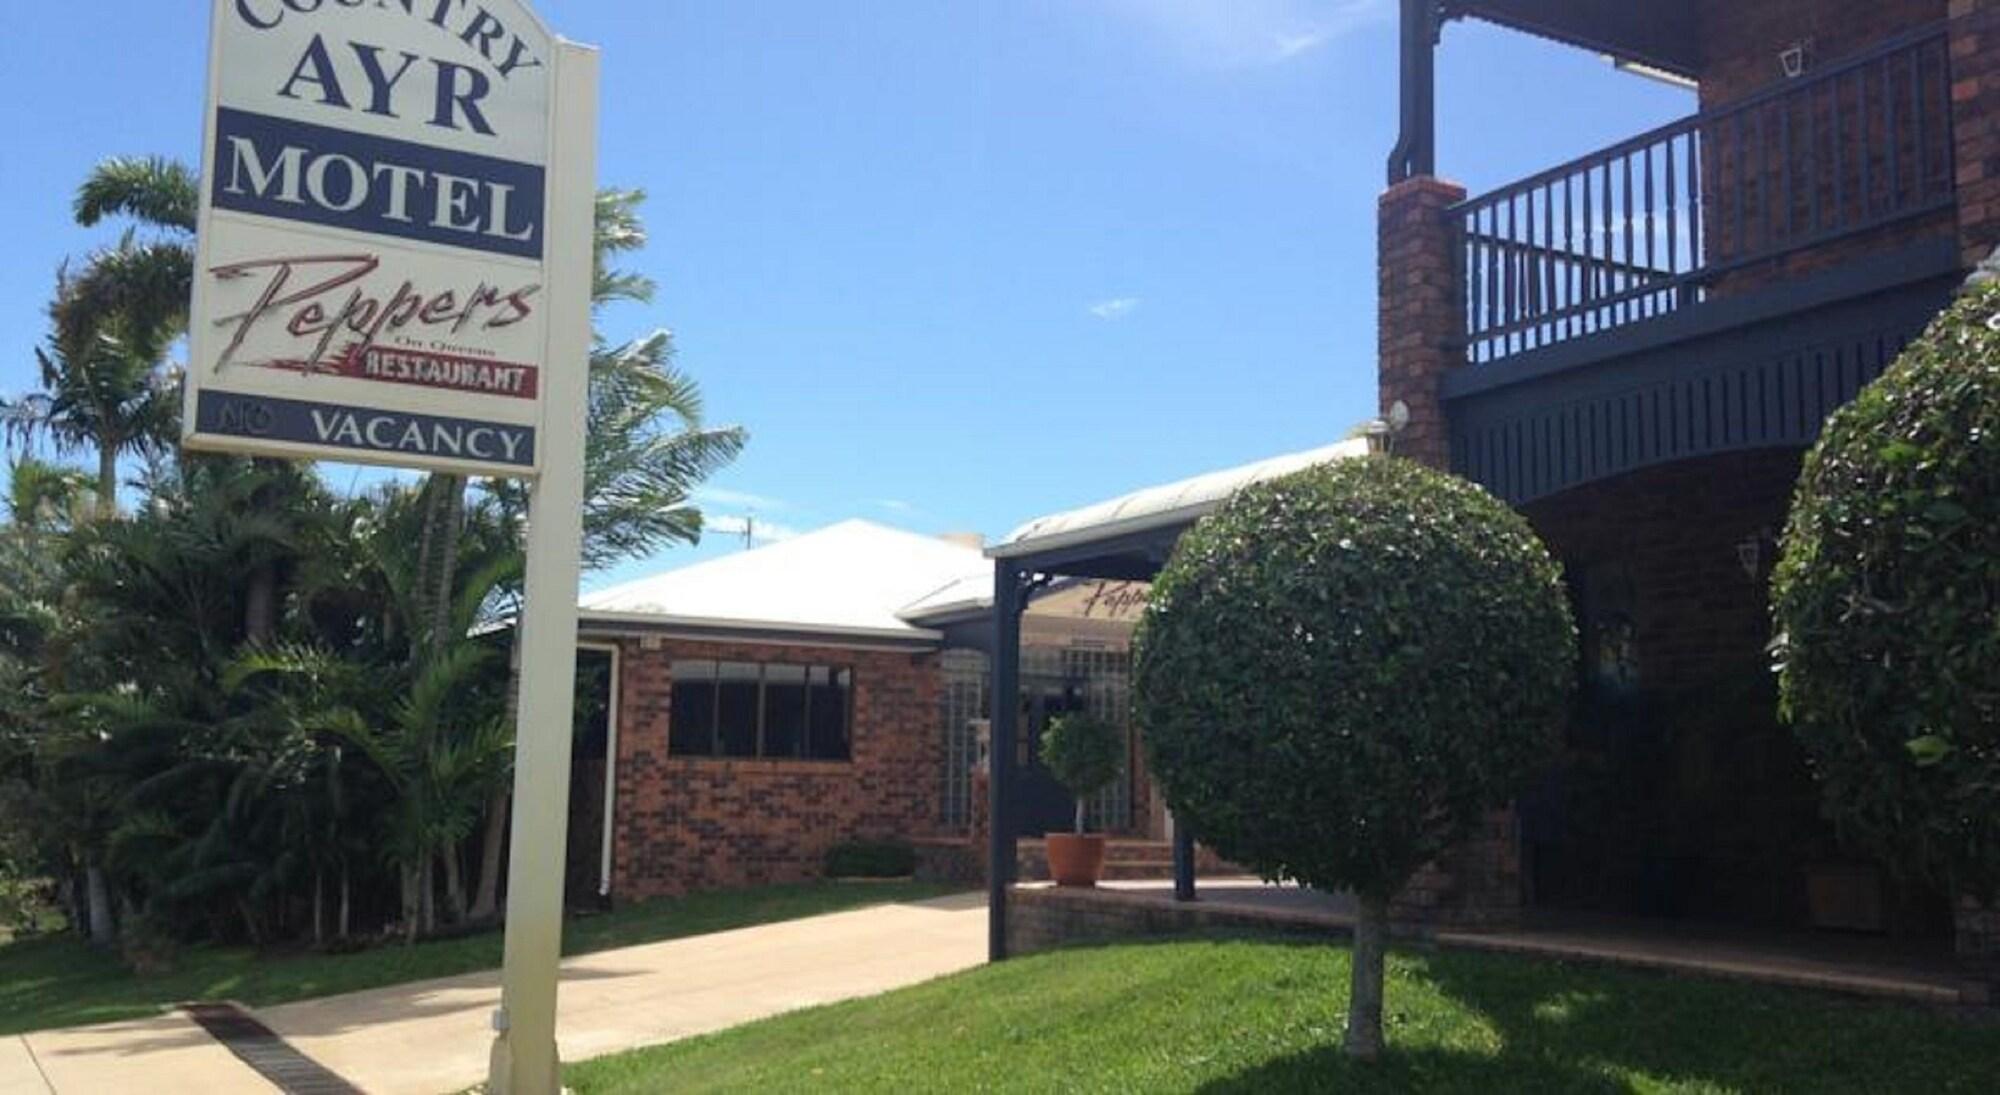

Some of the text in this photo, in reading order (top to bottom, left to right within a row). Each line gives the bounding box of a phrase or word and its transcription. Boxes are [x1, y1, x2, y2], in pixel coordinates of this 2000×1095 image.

[235, 0, 541, 80] CTRY
[277, 33, 497, 136] AYR
[224, 136, 533, 241] MOTEL
[209, 253, 541, 376] Peppers
[366, 351, 524, 392] RESTAURANT
[310, 410, 523, 461] VACANCY
